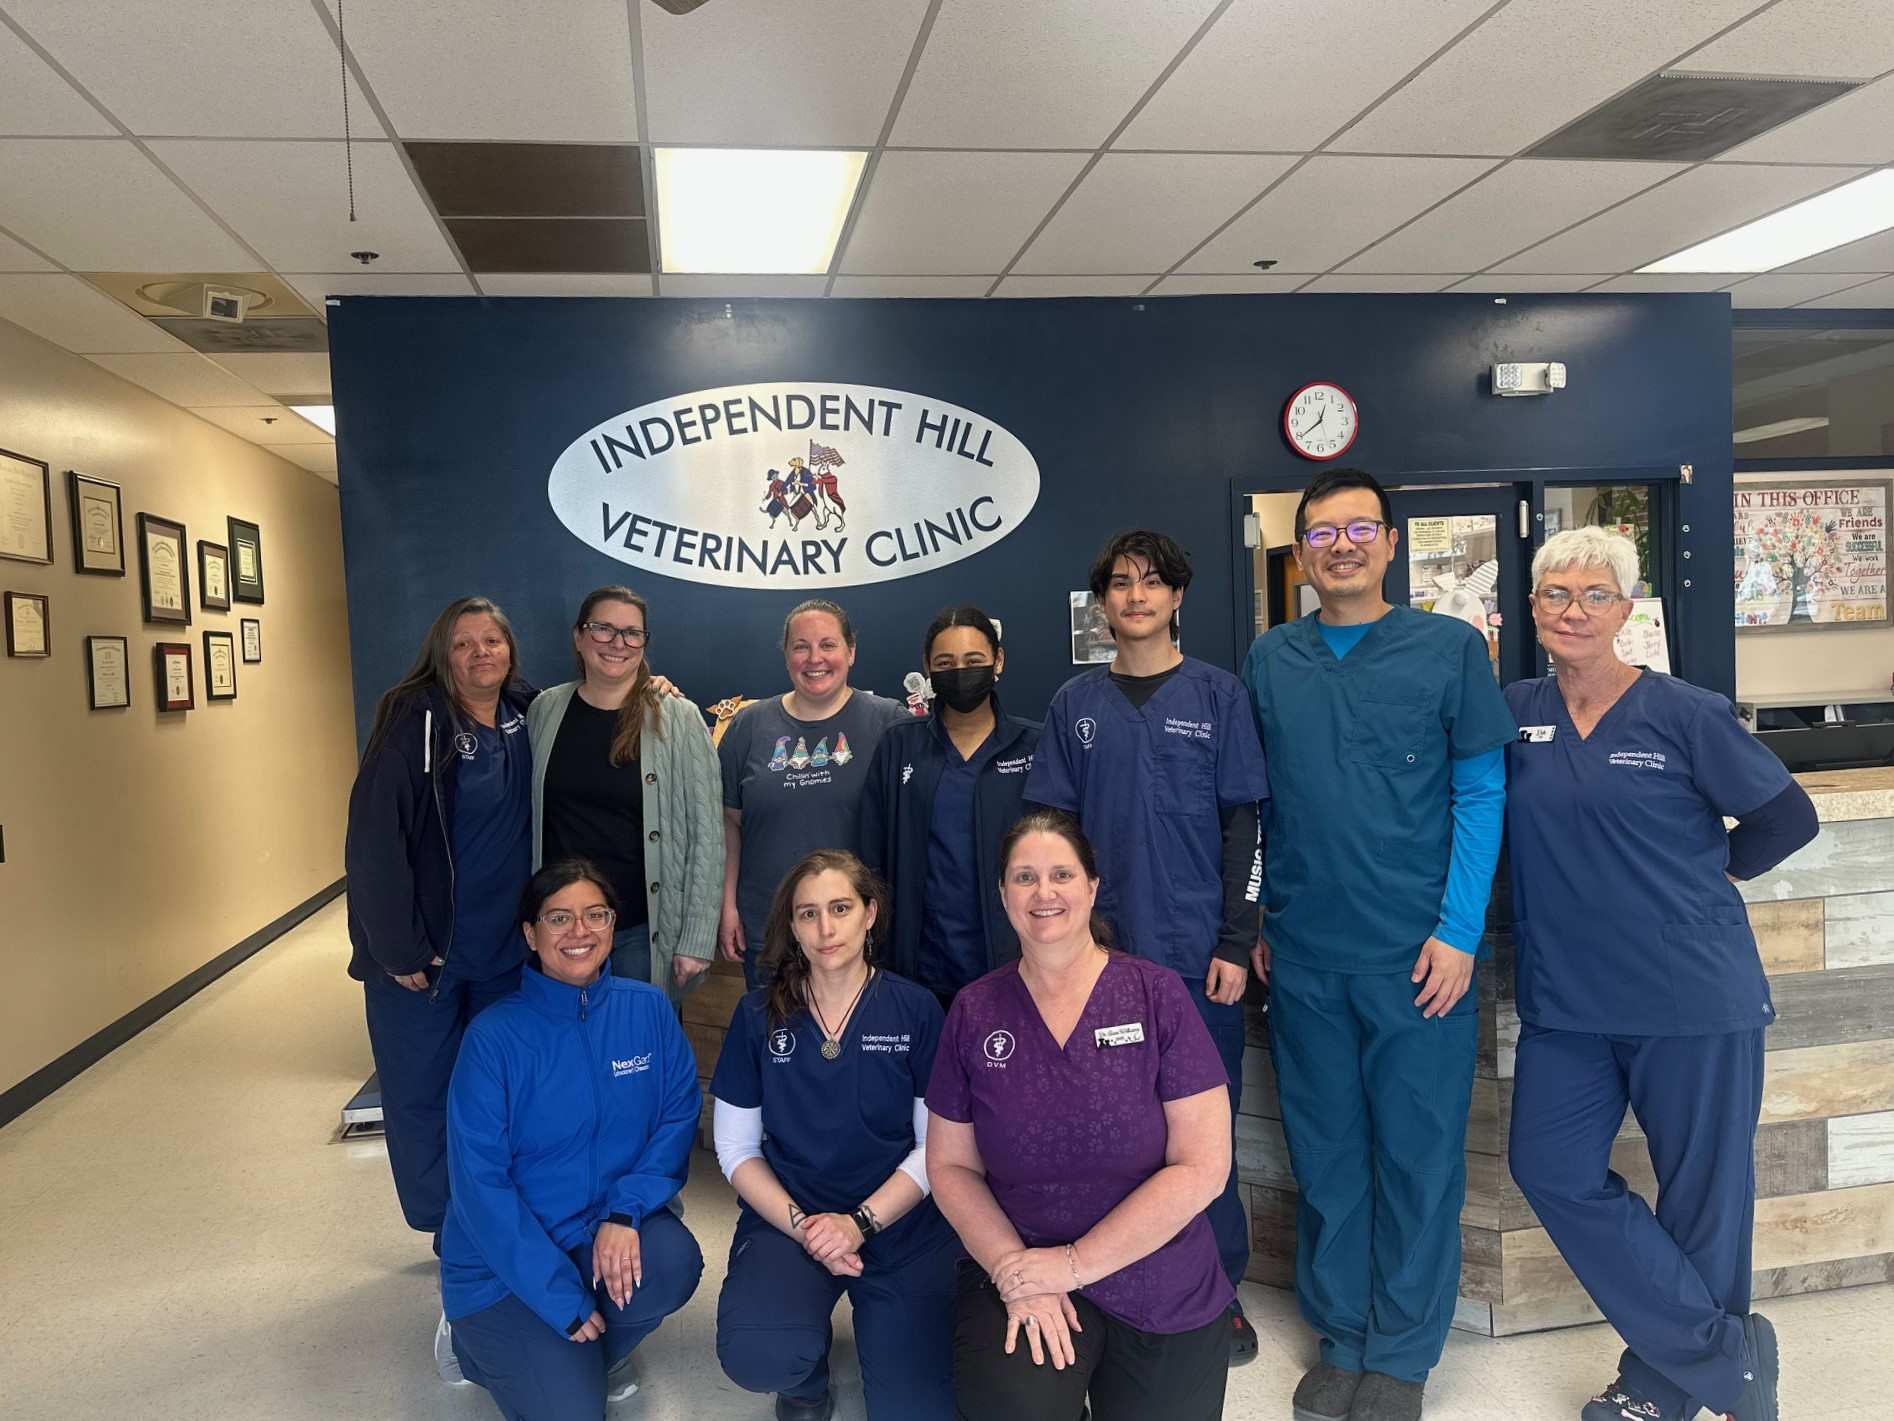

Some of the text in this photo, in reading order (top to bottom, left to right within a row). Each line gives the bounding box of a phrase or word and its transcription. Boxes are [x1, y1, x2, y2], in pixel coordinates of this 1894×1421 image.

[1304, 396, 1311, 404] 11
[1315, 392, 1324, 400] 12
[1295, 407, 1305, 415] 10
[1337, 404, 1344, 412] 2
[1342, 417, 1348, 425] 3
[590, 393, 995, 474] INDEPENDENT HILL
[1337, 431, 1344, 439] 4
[1306, 441, 1312, 449] 7
[1317, 444, 1324, 452] 6
[1329, 440, 1336, 448] 5
[1735, 489, 1860, 507] IN THIS OFFICE
[1839, 517, 1883, 528] Friends
[601, 496, 1002, 576] VETERINARY CLINIC
[1844, 562, 1886, 583] Together
[1841, 585, 1886, 595] WE ARE A
[1831, 603, 1883, 620] Team
[799, 777, 832, 786] Gnomes
[862, 1034, 900, 1043] Independent
[862, 1044, 910, 1053] Veterinary Clinic
